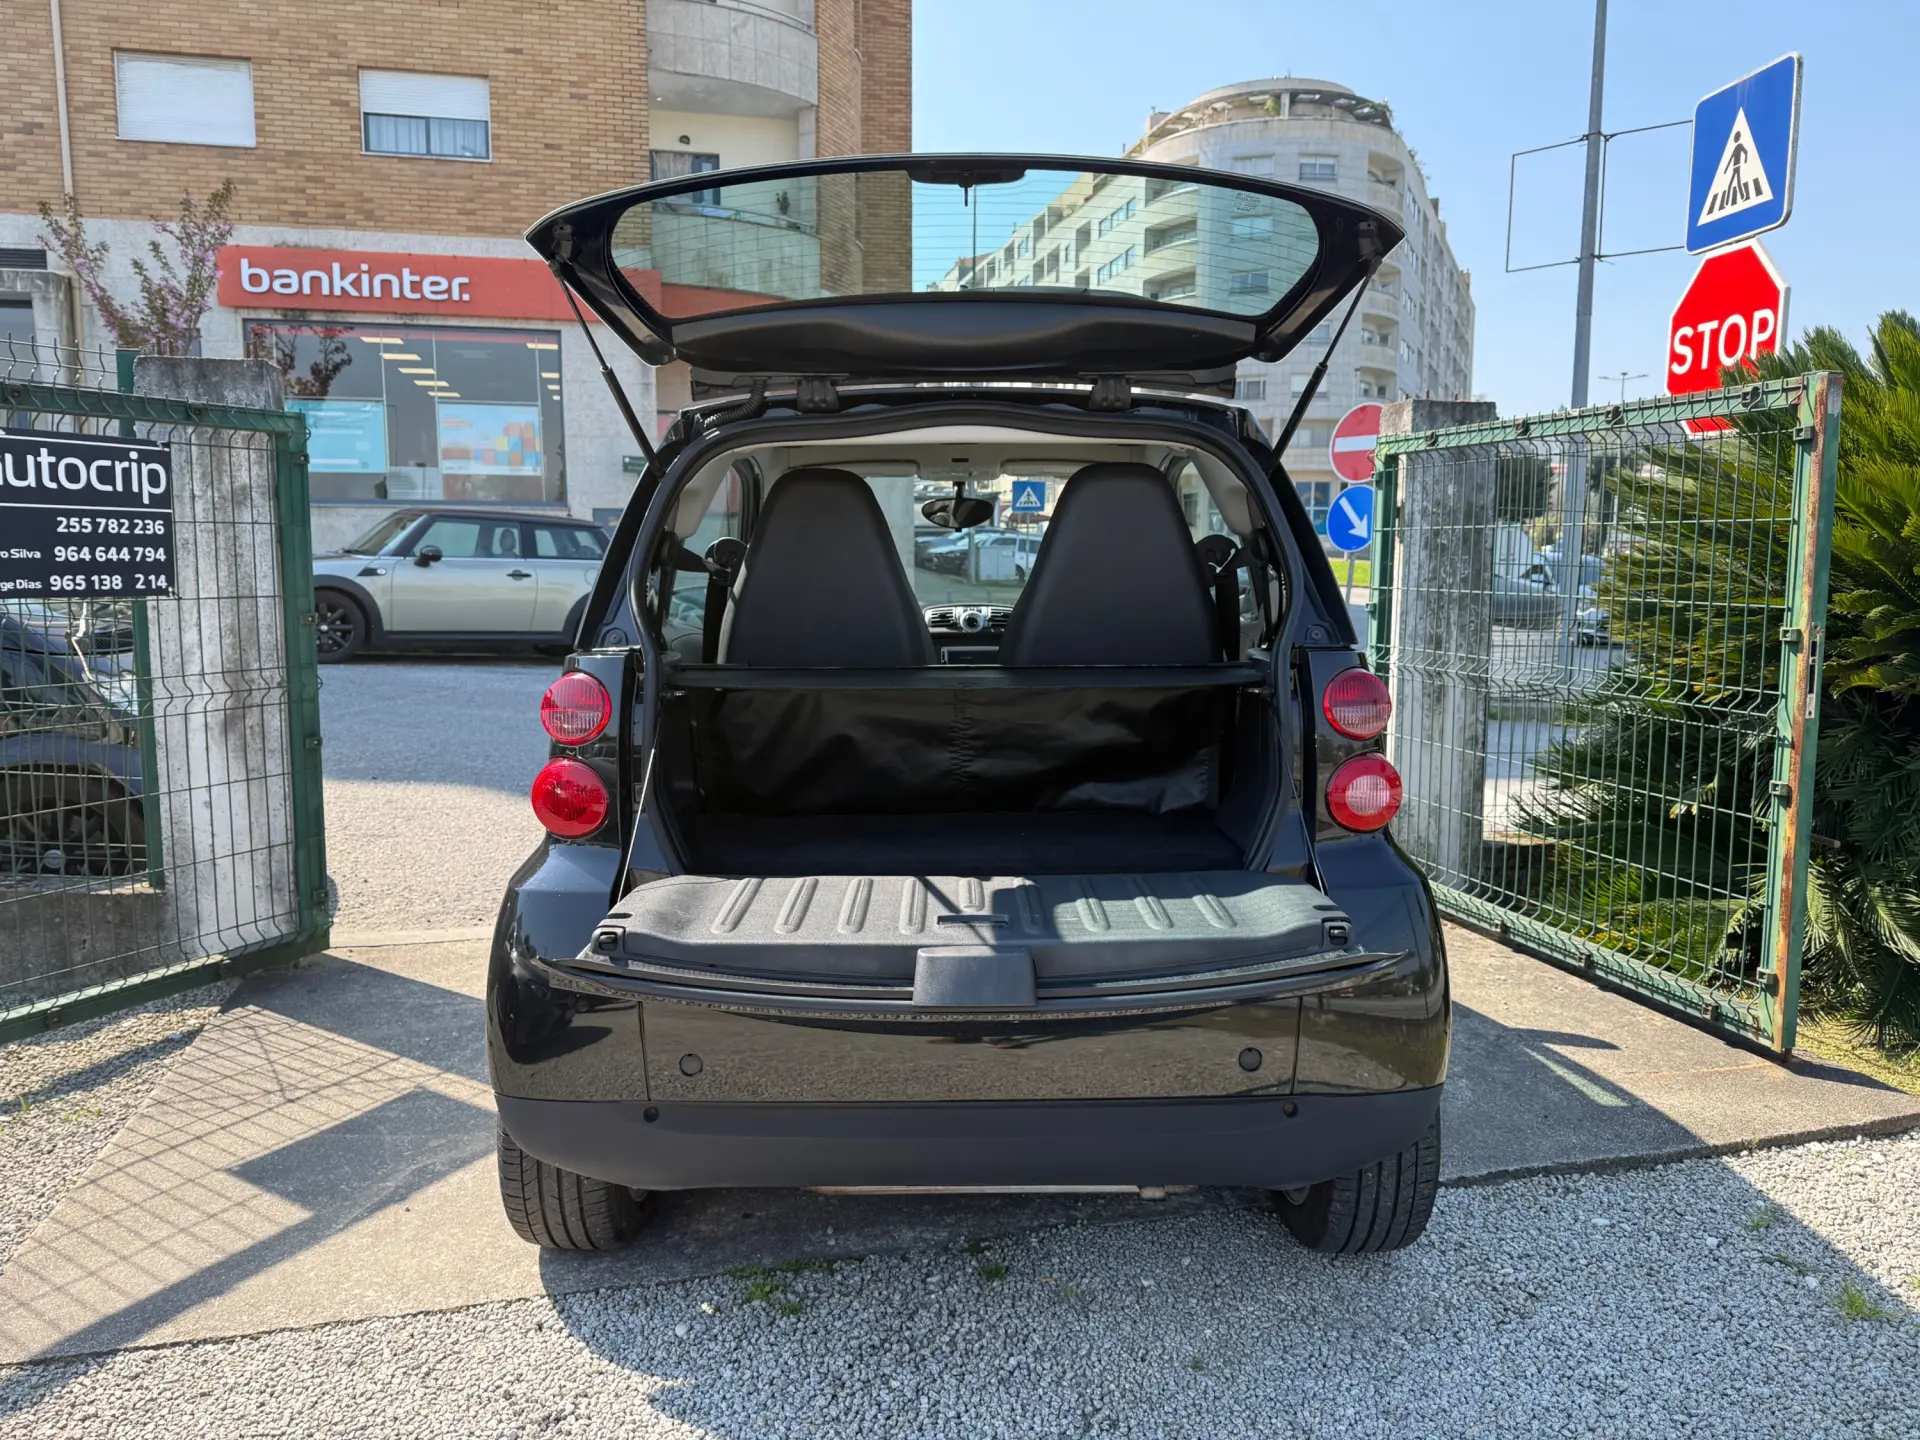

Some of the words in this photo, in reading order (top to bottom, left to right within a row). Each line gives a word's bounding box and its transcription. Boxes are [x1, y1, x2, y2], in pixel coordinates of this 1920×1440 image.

[240, 258, 470, 301] bankinter.
[1671, 308, 1775, 375] STOP
[0, 447, 167, 504] utocrip
[56, 517, 92, 533] 255
[96, 518, 130, 534] 782
[133, 520, 165, 535] 236
[10, 548, 42, 559] Silva
[54, 546, 91, 562] 964
[95, 547, 130, 562] 644
[134, 547, 167, 562] 794
[15, 578, 43, 589] Dias
[50, 575, 86, 591] 965
[91, 575, 123, 590] 138
[135, 574, 168, 589] 214
